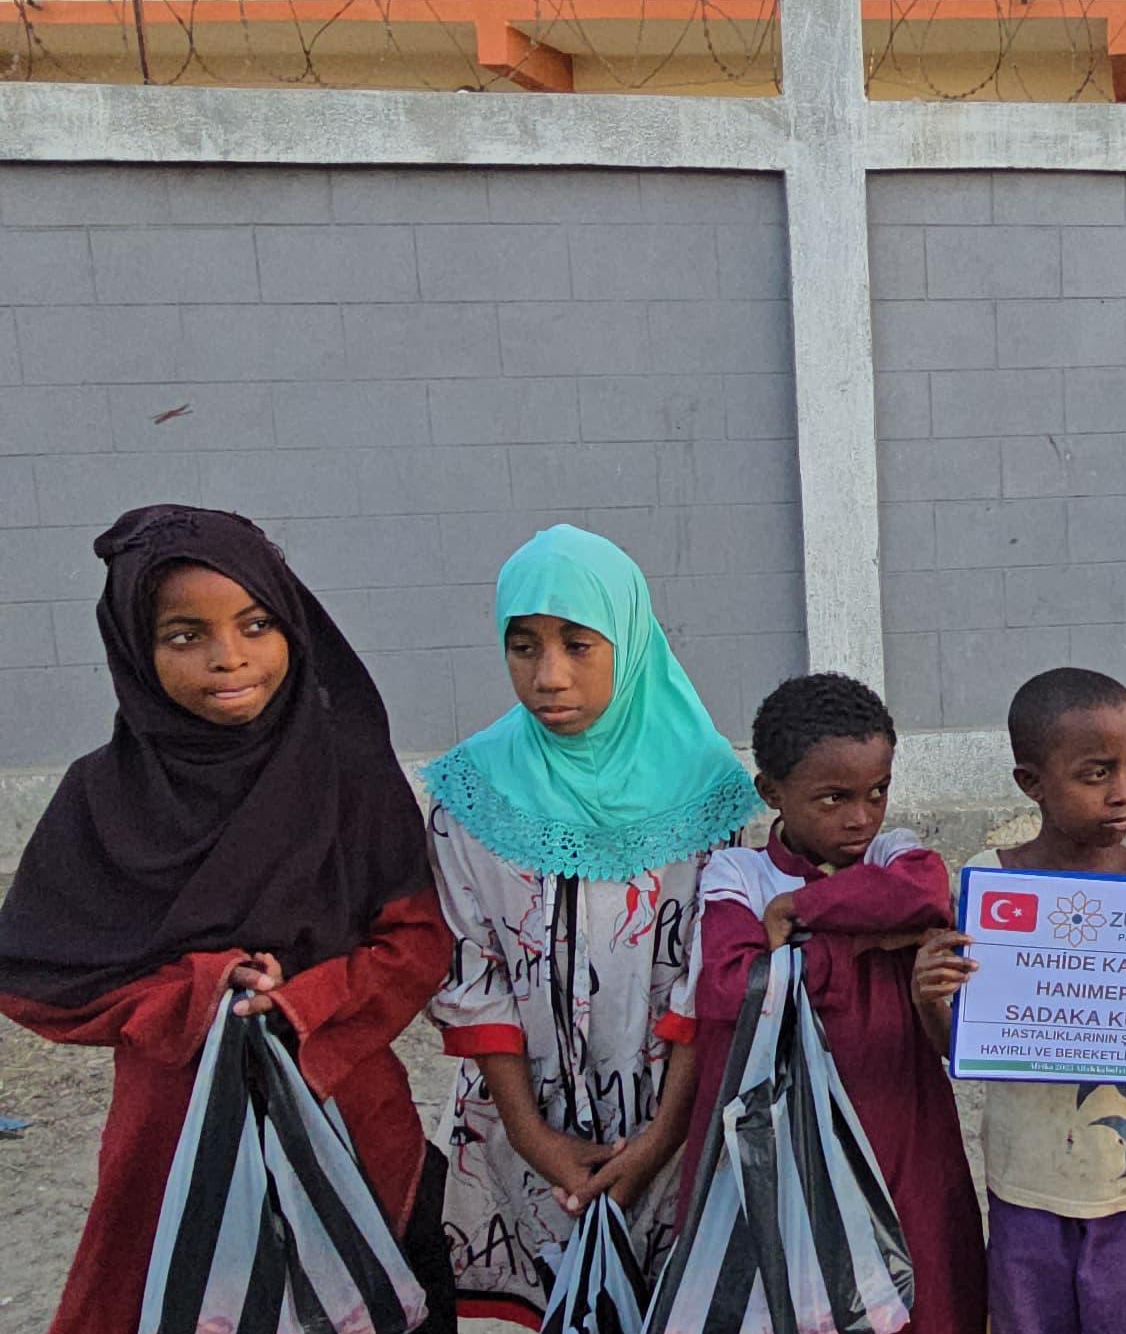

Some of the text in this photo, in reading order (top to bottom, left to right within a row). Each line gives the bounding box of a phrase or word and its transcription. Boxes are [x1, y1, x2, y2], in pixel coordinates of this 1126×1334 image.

[1016, 951, 1096, 972] NAHİDE
[1005, 1005, 1101, 1027] SADAKA
[1001, 1027, 1118, 1044] HASTALIKLARININ
[980, 1044, 1032, 1057] HAYIRLI
[1035, 1047, 1052, 1058] VE
